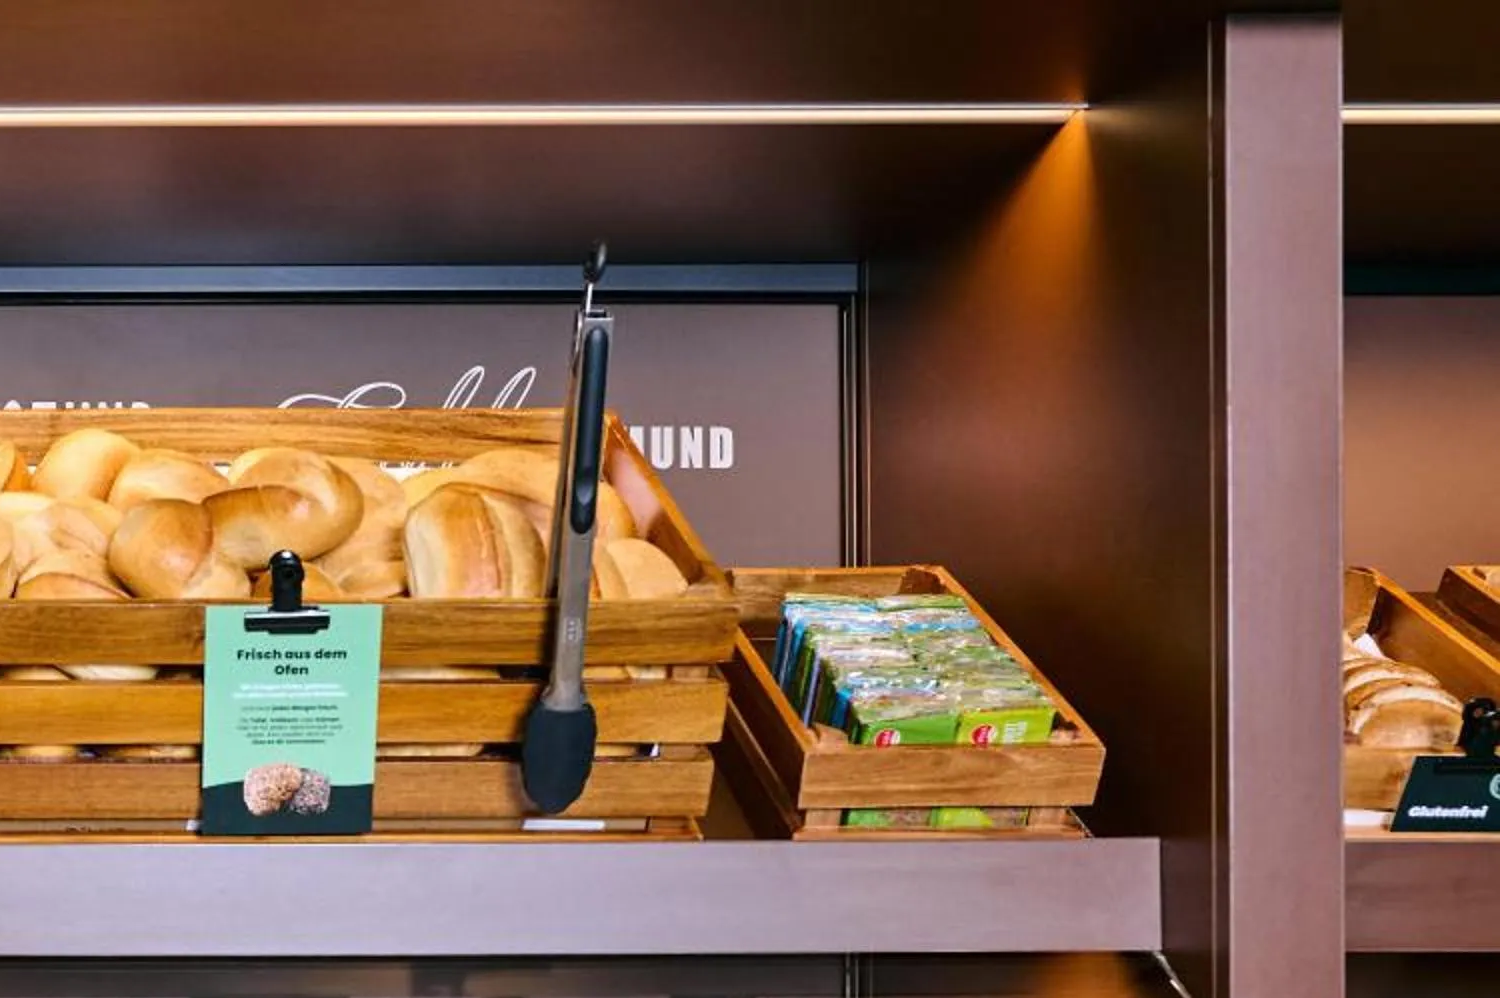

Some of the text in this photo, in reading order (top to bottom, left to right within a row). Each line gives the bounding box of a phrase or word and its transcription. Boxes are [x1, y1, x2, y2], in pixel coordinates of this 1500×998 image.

[237, 648, 347, 661] Frisch aus dem
[274, 665, 309, 676] Ofen
[1408, 805, 1489, 818] Glutenfrei
